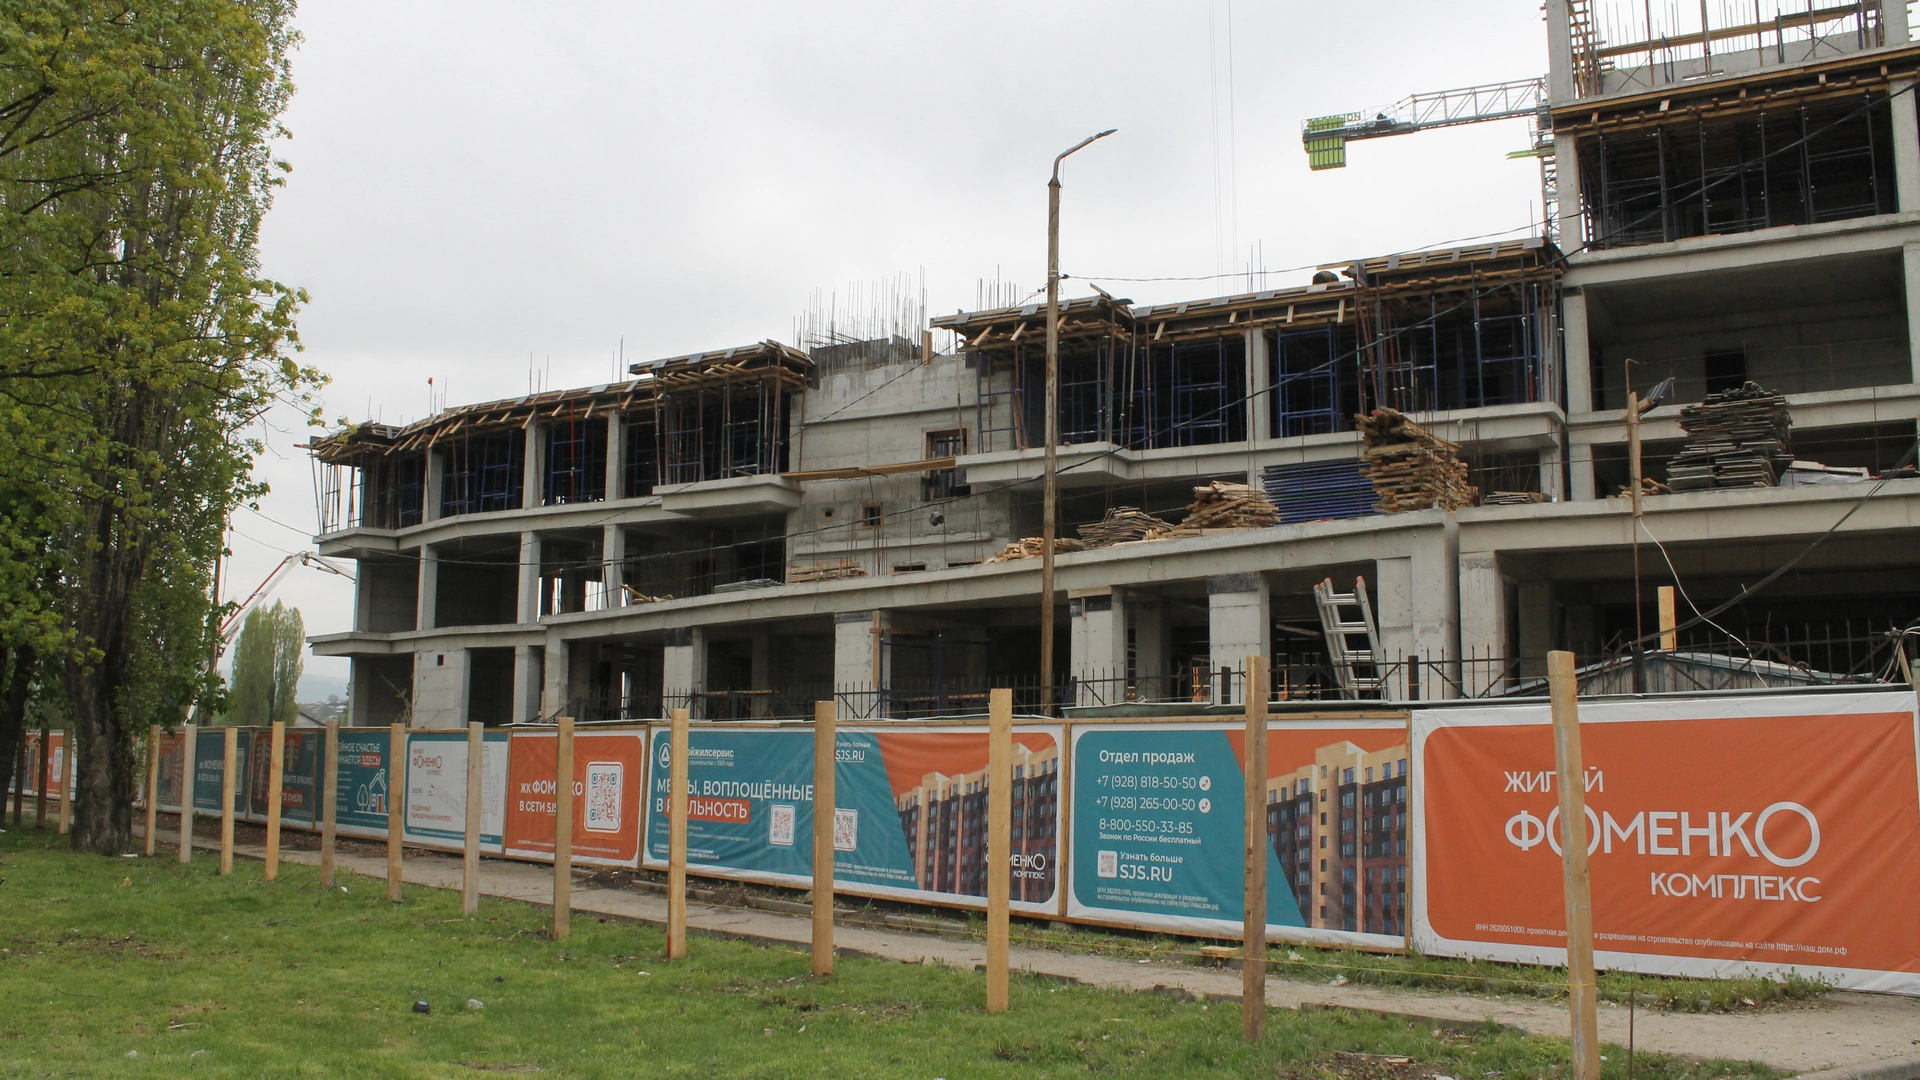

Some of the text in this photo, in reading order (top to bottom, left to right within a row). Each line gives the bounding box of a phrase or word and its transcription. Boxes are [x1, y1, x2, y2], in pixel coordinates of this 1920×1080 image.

[338, 741, 380, 753] ЕЙНОЕ СЧАСТЬЕ
[688, 747, 734, 759] ойжилсервис
[338, 755, 360, 764] ИНАЕТСЯ
[835, 750, 864, 761] SJS.RU
[1100, 750, 1195, 766] Отдел продаж
[1096, 775, 1196, 790] +7 (928) 818-50-50
[1503, 766, 1604, 793] ЖИЛЙ
[657, 778, 814, 801] МЕЫ, ВОПЛОЩЁННЫЕ
[519, 800, 524, 812] В
[526, 801, 546, 813] СЕТИ
[656, 798, 748, 818] В РЛЬНОСТЬ
[1096, 796, 1196, 812] +7 (928) 265-00-50
[1099, 818, 1193, 834] 8-800-550-33-85
[1098, 832, 1122, 840] Звонок
[1133, 834, 1158, 842] России
[1158, 834, 1202, 845] бесплатный
[1504, 801, 1821, 868] ФОМЕНКО
[1120, 851, 1184, 864] Узнать больше
[1120, 864, 1173, 882] SJS.RU
[1650, 872, 1822, 903] КОМПЛЕКС
[1475, 923, 1489, 932] ИНН
[1489, 924, 1526, 934] 2628051000,
[1526, 928, 1557, 937] проектная
[1600, 932, 1637, 942] разрешение
[1647, 936, 1694, 946] строительство
[1694, 937, 1744, 948] опубликованы
[1745, 941, 1754, 949] на
[1754, 941, 1775, 950] сайте
[1776, 942, 1848, 956] https://наш.дом.рф
